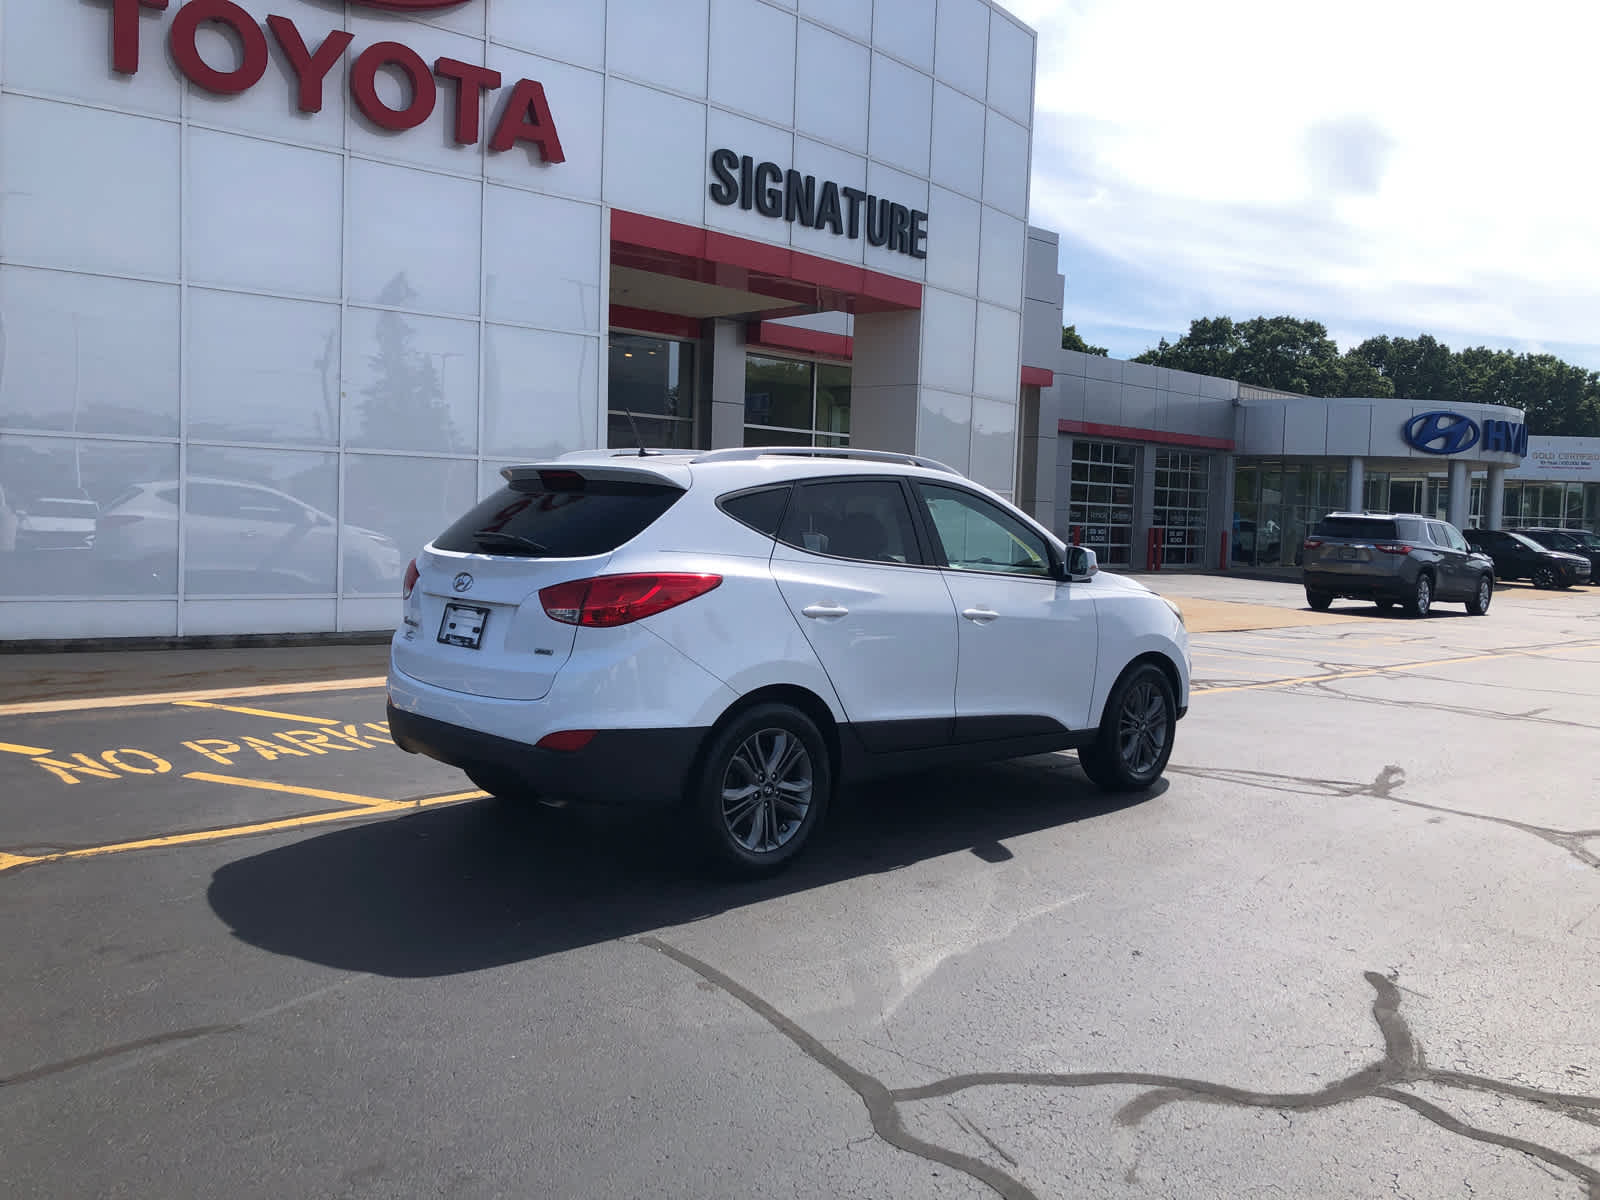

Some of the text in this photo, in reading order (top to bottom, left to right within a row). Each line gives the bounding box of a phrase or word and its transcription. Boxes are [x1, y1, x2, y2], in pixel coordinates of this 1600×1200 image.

[112, 0, 565, 163] TOYOTA
[710, 148, 928, 259] SIGNATURE
[31, 749, 172, 784] NO
